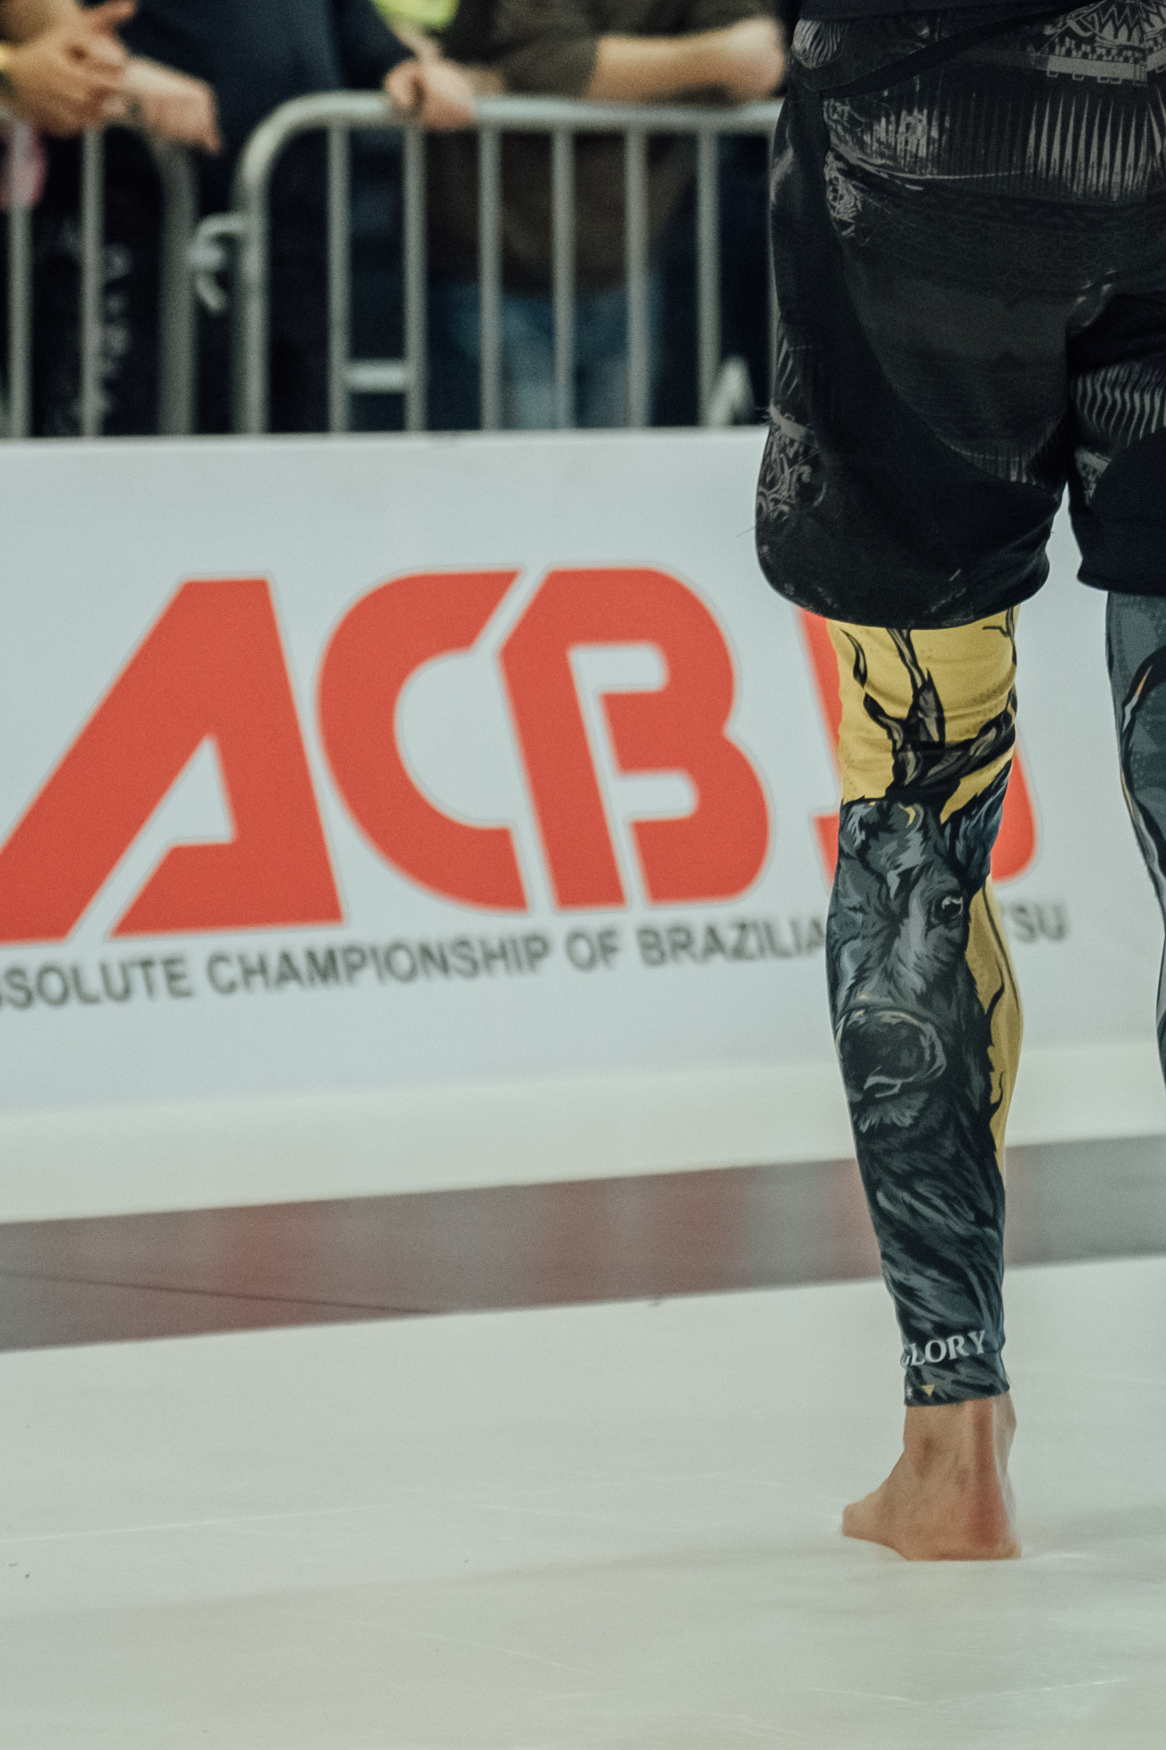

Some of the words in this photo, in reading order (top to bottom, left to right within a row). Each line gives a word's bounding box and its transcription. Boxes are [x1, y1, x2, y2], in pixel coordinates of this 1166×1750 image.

[0, 954, 195, 1011] SOLUTE
[206, 932, 551, 996] CHAMPIONSHIP
[565, 925, 622, 972] OF
[635, 913, 827, 967] BRAZILIA
